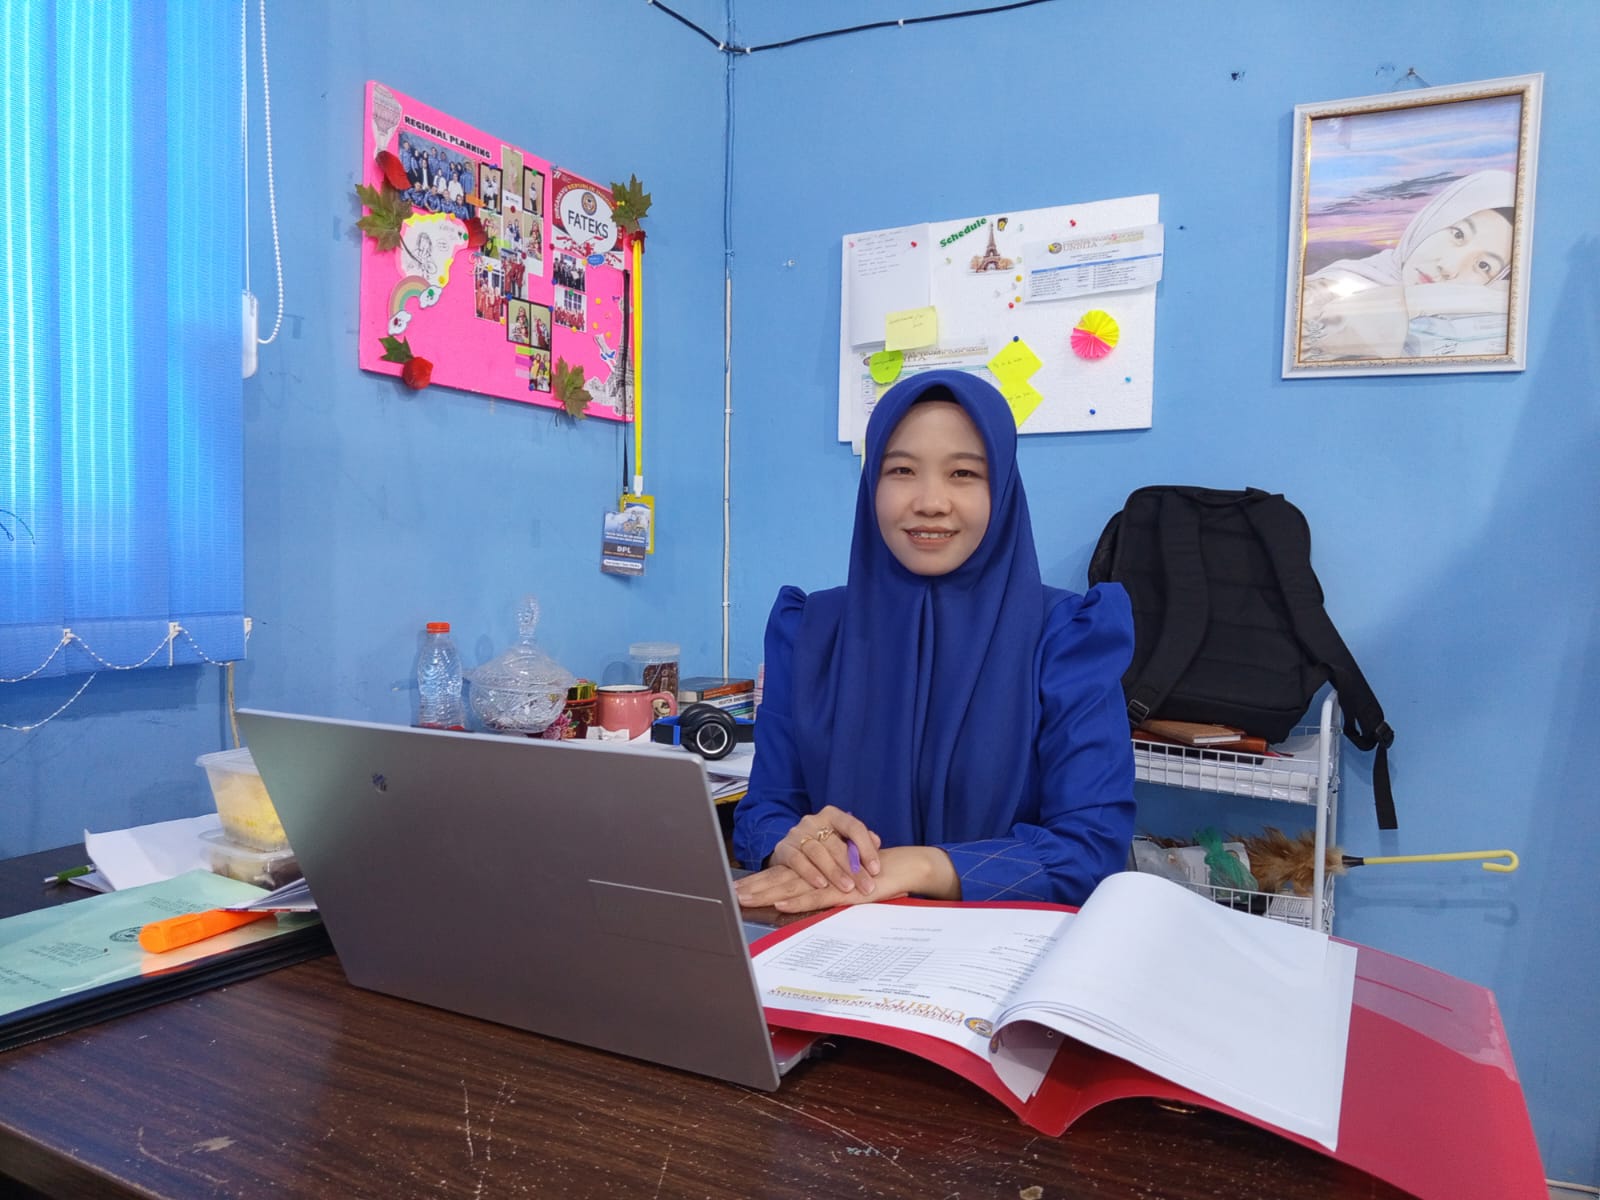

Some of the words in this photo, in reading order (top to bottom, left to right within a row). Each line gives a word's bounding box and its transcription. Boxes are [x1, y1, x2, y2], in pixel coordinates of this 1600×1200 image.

[404, 116, 448, 141] REGIONAL
[449, 135, 491, 159] PLANNING
[568, 210, 608, 239] FATEKS
[939, 217, 987, 248] Schedule
